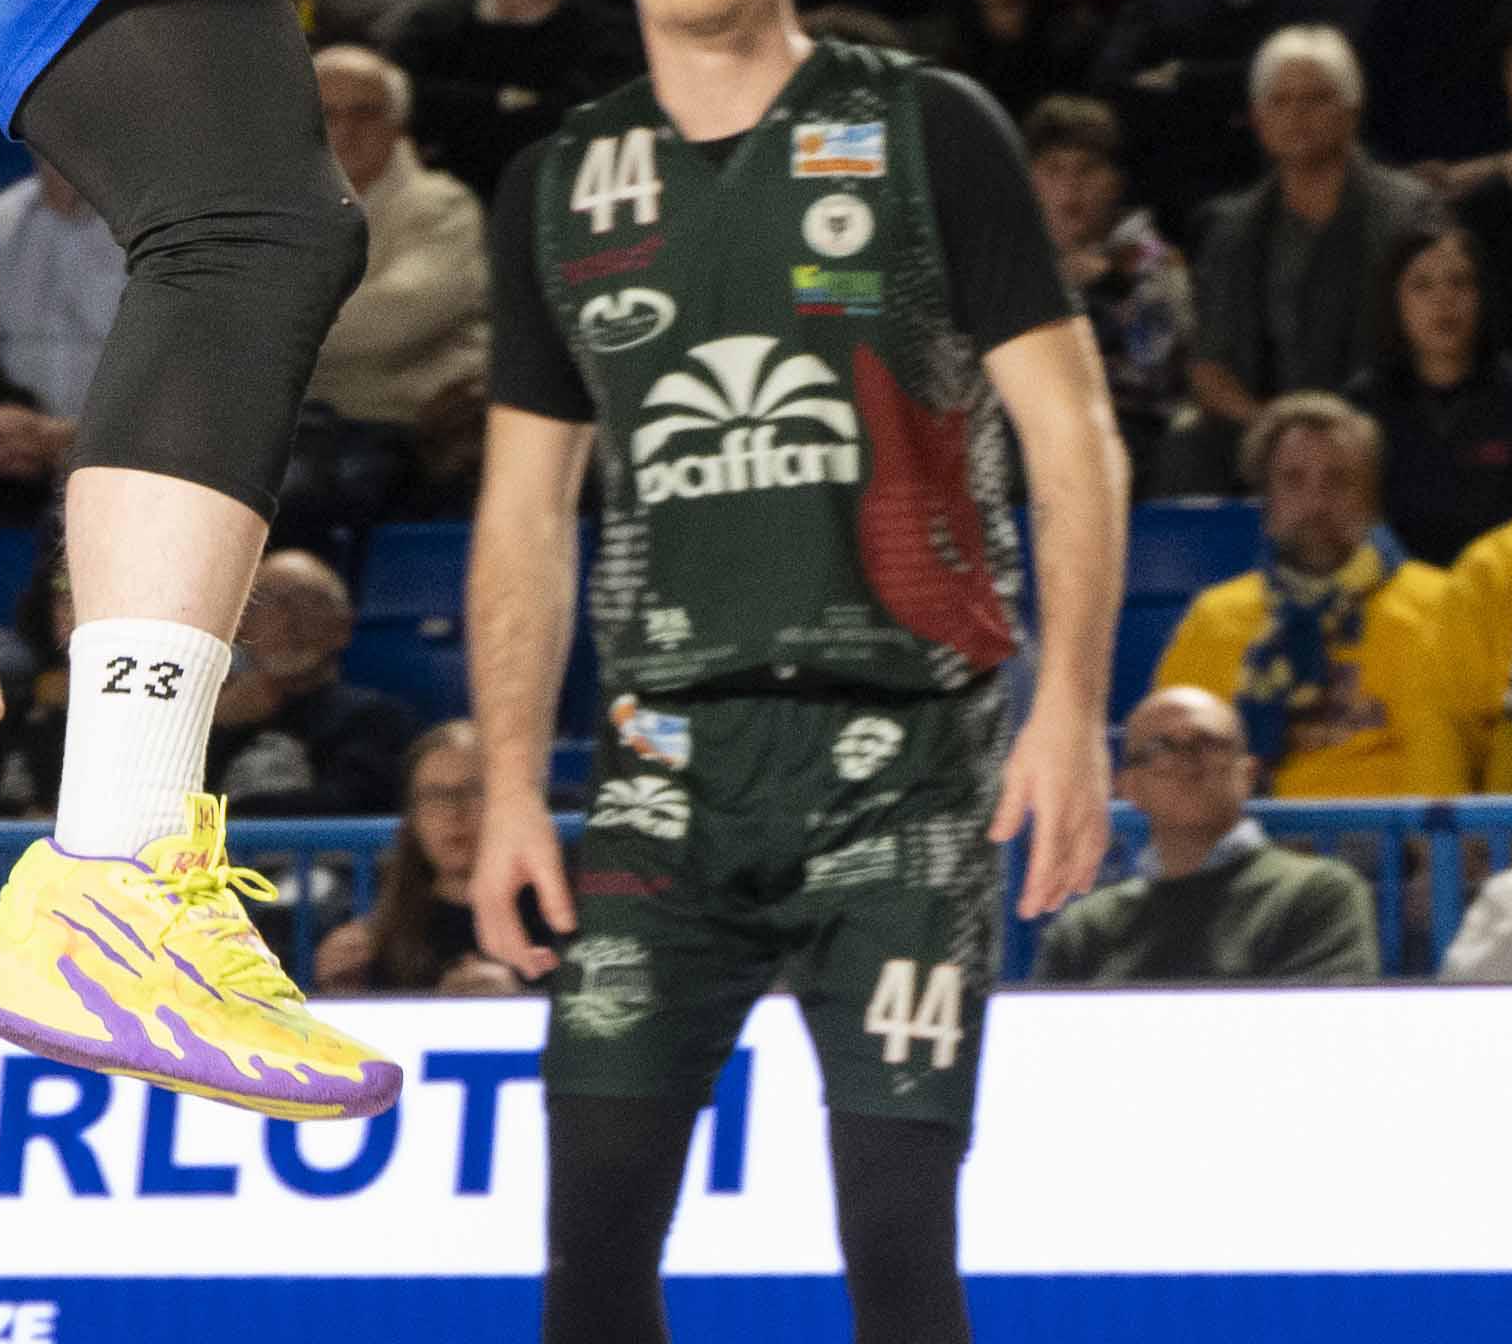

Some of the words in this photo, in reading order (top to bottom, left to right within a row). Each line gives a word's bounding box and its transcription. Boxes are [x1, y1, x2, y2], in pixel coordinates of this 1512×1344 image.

[568, 127, 665, 235] 44
[101, 656, 185, 701] 23
[862, 958, 964, 1069] 44
